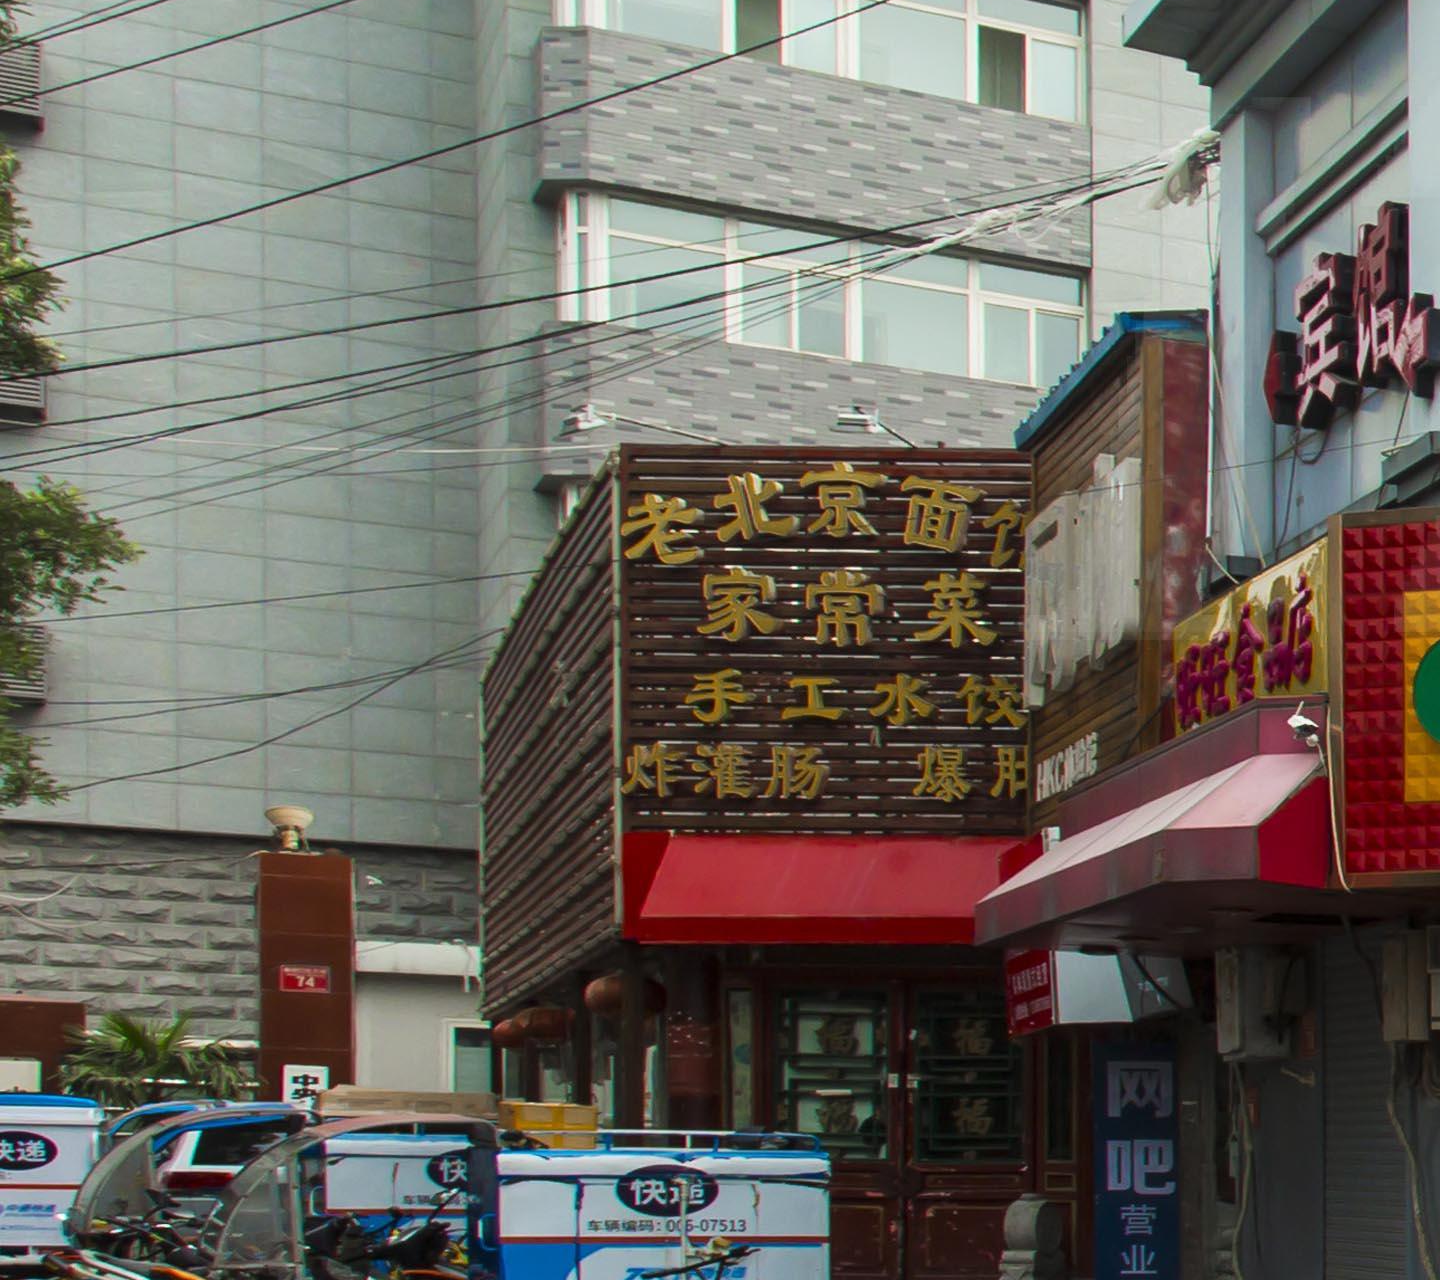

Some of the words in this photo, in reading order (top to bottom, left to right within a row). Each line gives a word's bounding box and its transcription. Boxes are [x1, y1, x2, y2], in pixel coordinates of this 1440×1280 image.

[697, 566, 998, 648] 家常菜
[685, 668, 1028, 728] 手工水饺
[621, 742, 831, 800] 炸灌肠
[1105, 1060, 1176, 1197] 网吧
